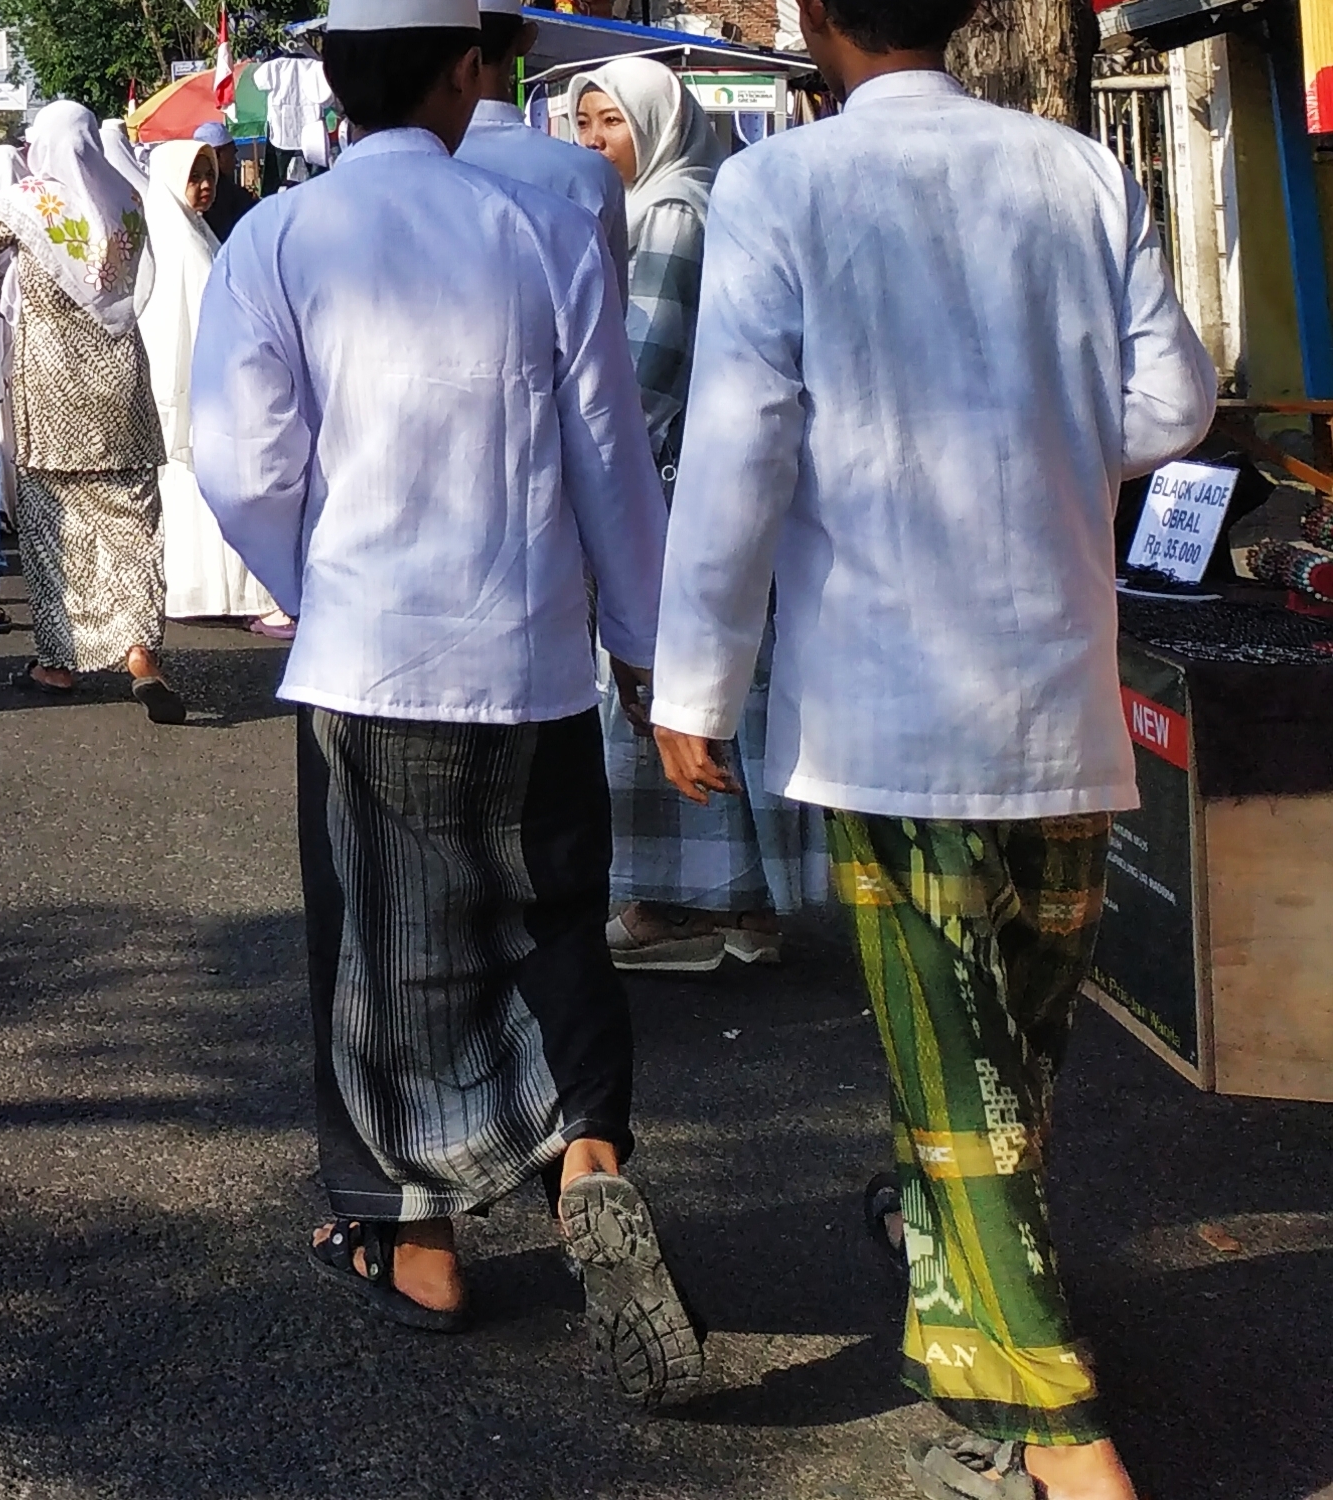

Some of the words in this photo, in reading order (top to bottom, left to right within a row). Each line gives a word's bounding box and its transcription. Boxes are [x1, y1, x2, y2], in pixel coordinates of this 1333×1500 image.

[1152, 475, 1195, 501] BLACK
[1194, 483, 1230, 508] JADE
[1162, 508, 1201, 534] OBRAL
[1164, 538, 1202, 565] 35.000
[1133, 701, 1169, 749] NEW
